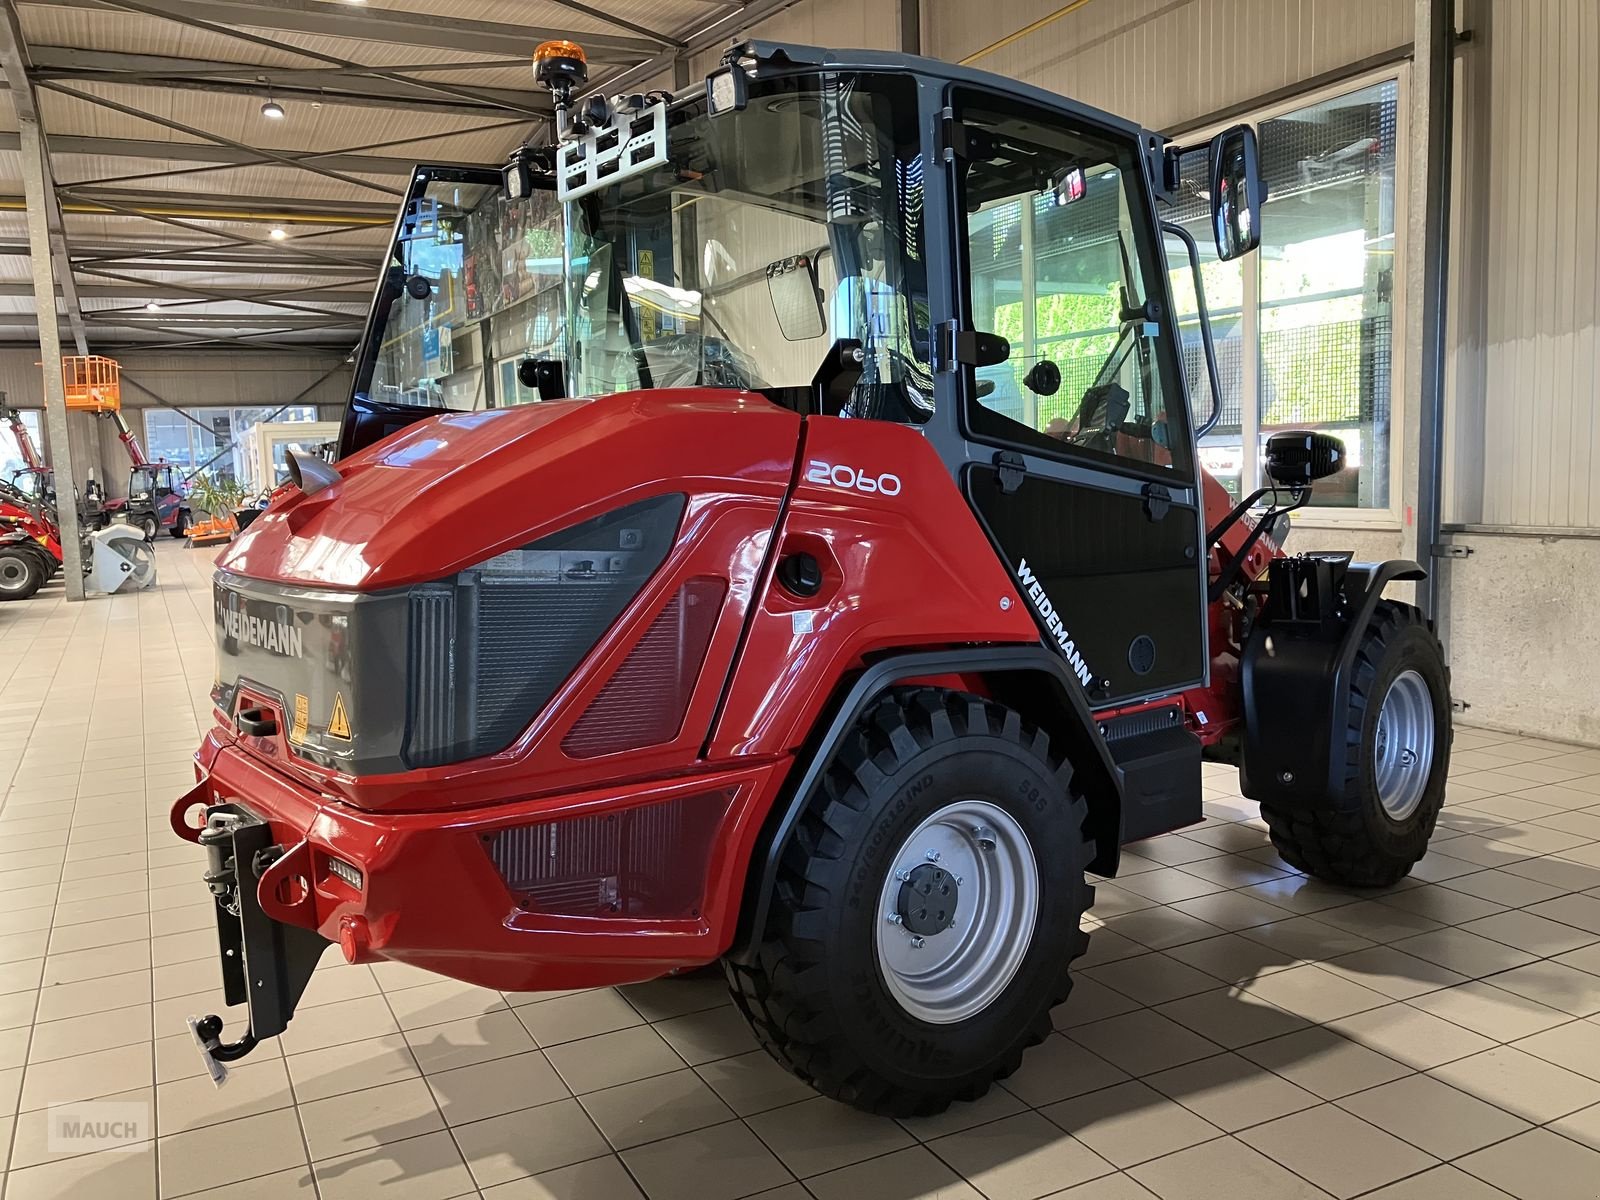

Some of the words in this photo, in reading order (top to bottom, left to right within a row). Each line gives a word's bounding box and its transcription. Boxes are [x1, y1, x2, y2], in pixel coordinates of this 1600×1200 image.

[808, 460, 901, 496] 2060
[223, 608, 302, 659] WEIDEMANN
[1017, 558, 1093, 687] WEIDEMANN
[906, 774, 934, 802] IND
